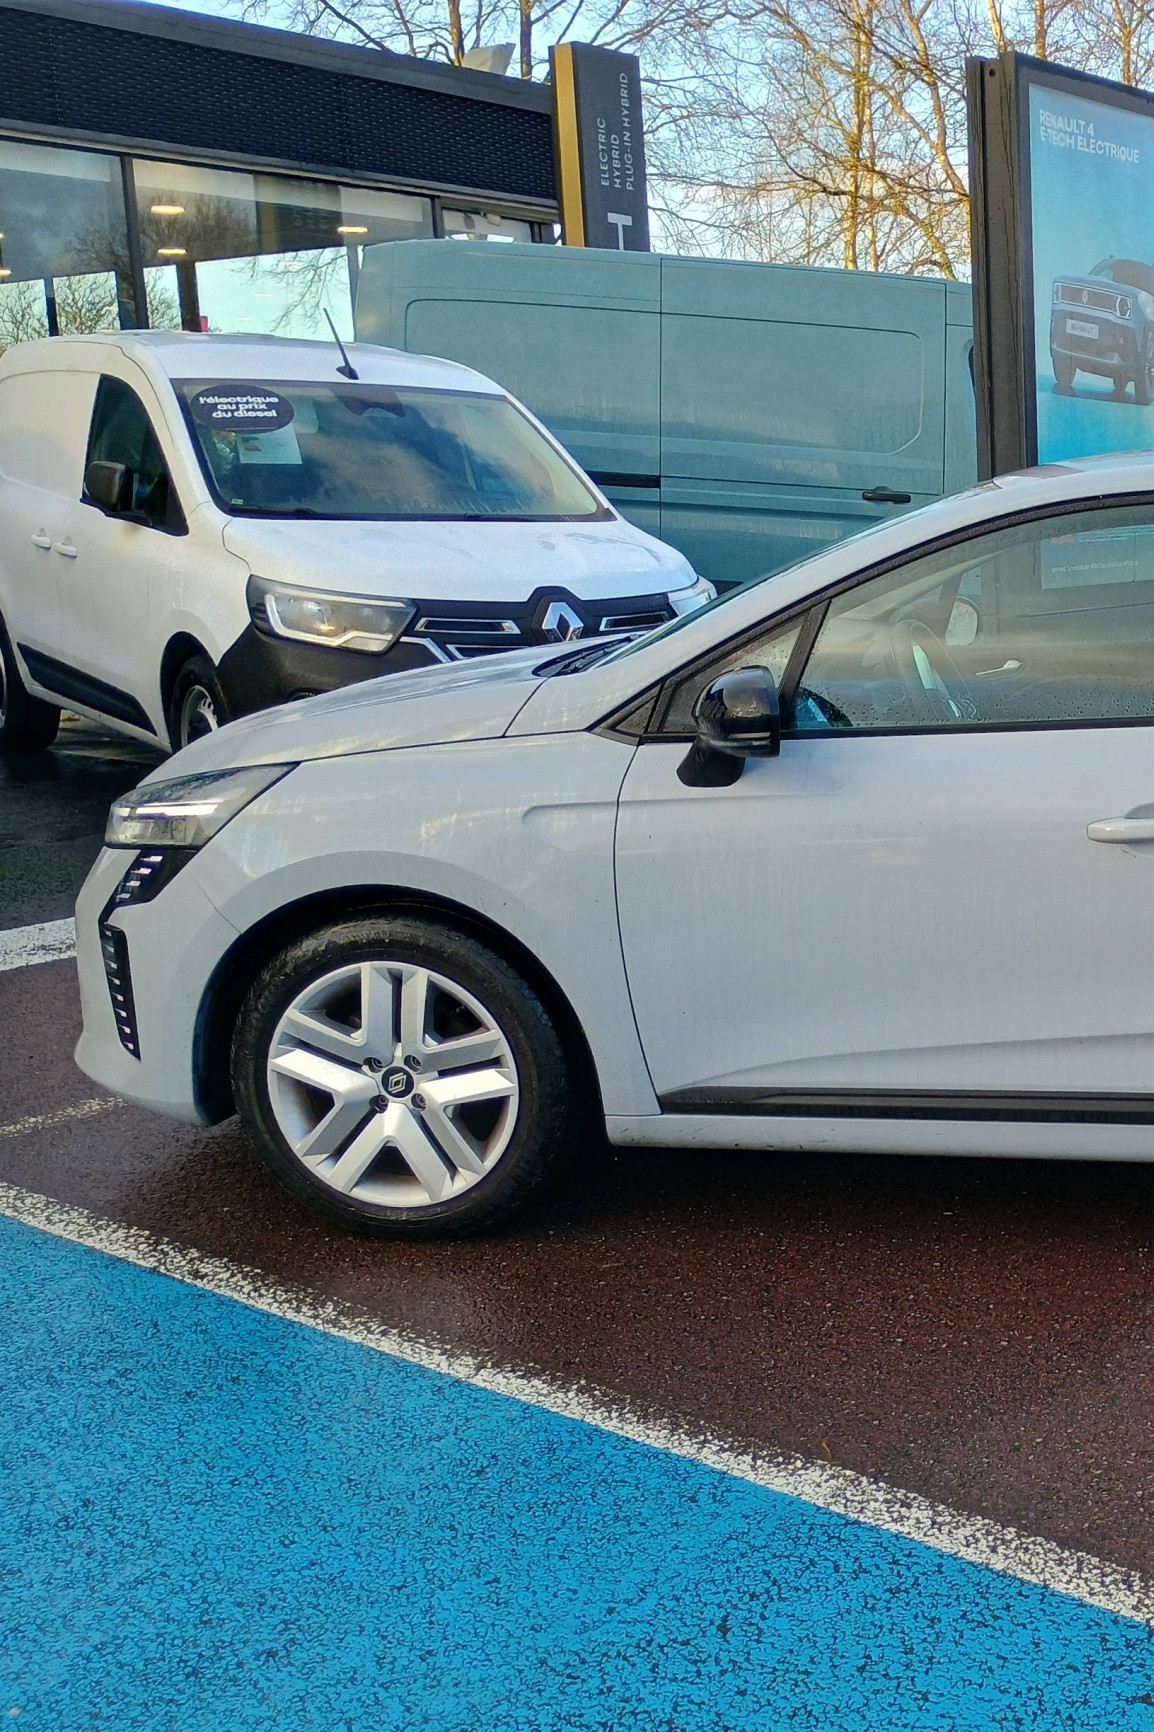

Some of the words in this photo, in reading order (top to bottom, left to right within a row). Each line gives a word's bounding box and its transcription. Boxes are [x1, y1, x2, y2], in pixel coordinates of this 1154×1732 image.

[619, 72, 631, 128] HYBRID
[1039, 109, 1086, 134] RENAULT
[1087, 122, 1095, 137] 4
[1040, 127, 1076, 150] E-TECH
[1077, 136, 1140, 163] ELECTRIQUE
[596, 117, 610, 186] ELECTRIC
[611, 134, 622, 189] HYBRID
[623, 131, 635, 191] PLUG-IN
[212, 410, 232, 418] du
[233, 409, 278, 417] diesel
[238, 402, 268, 411] prix
